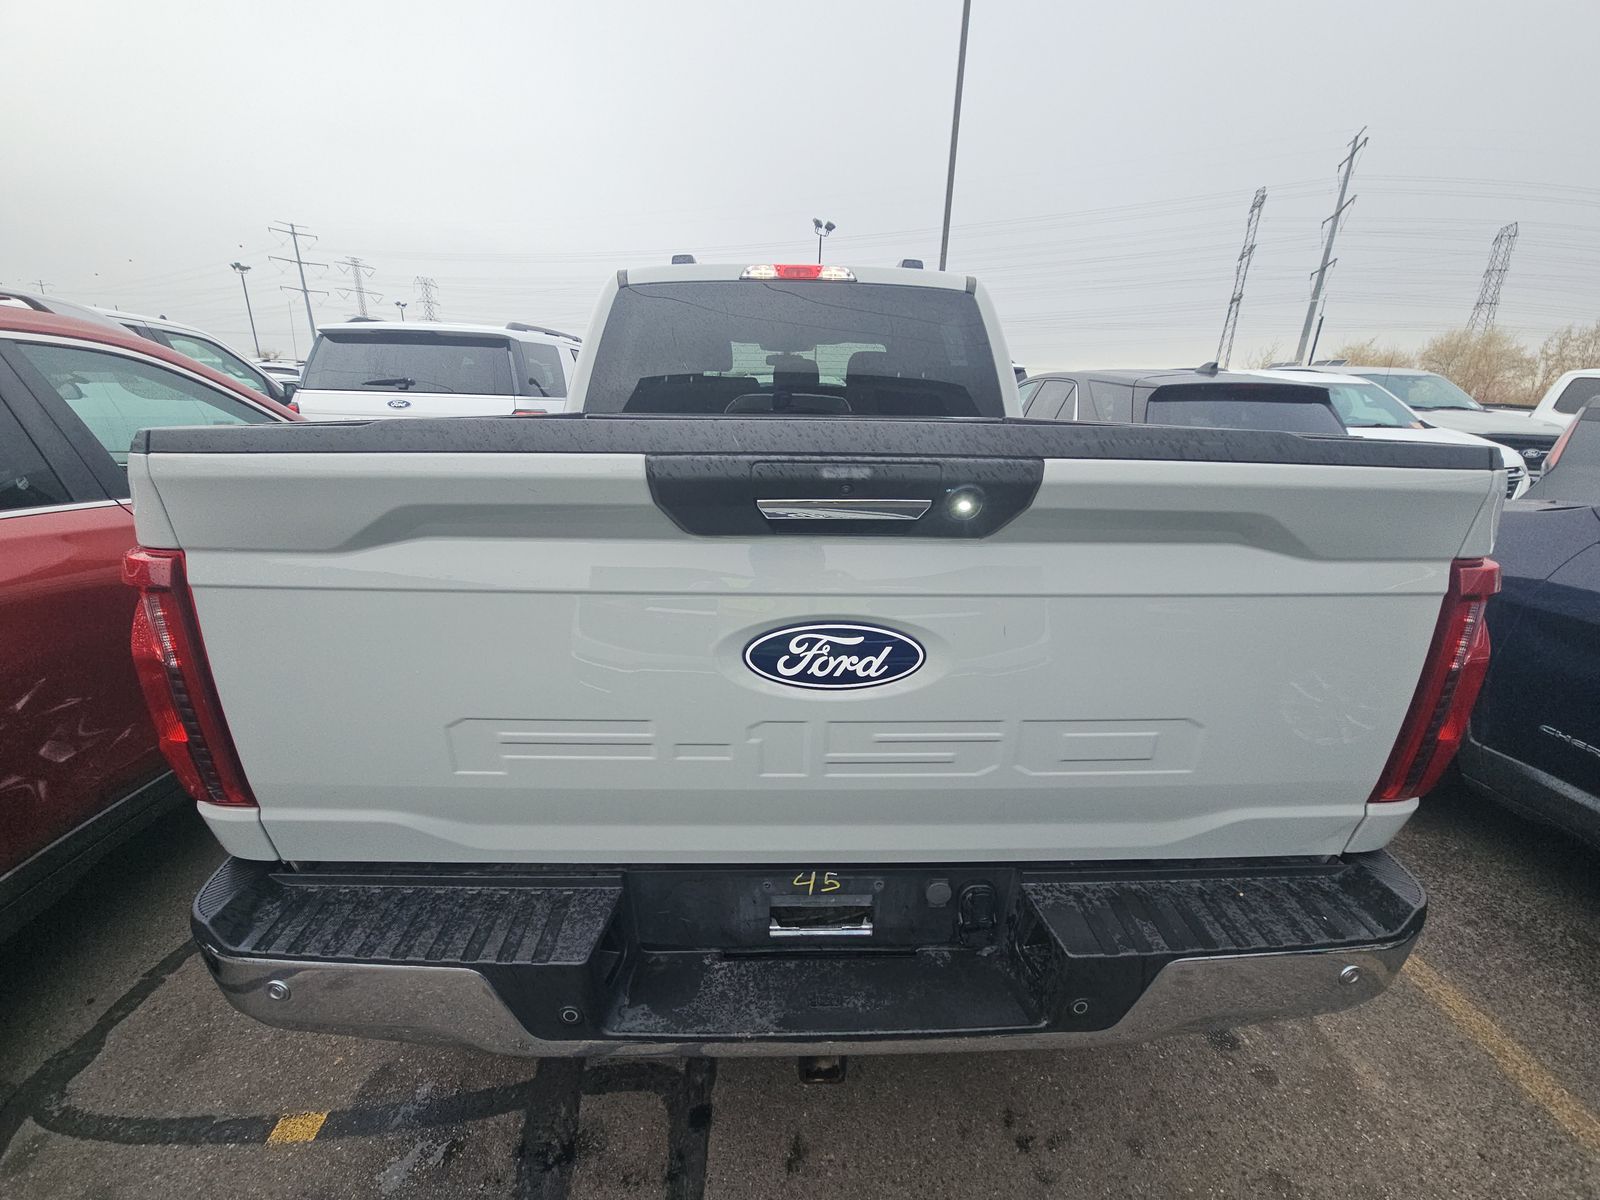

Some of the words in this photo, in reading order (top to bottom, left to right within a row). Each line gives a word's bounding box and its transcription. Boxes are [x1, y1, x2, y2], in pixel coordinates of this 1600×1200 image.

[777, 633, 893, 678] Ford
[446, 717, 1205, 779] F-150
[793, 871, 841, 896] 45
